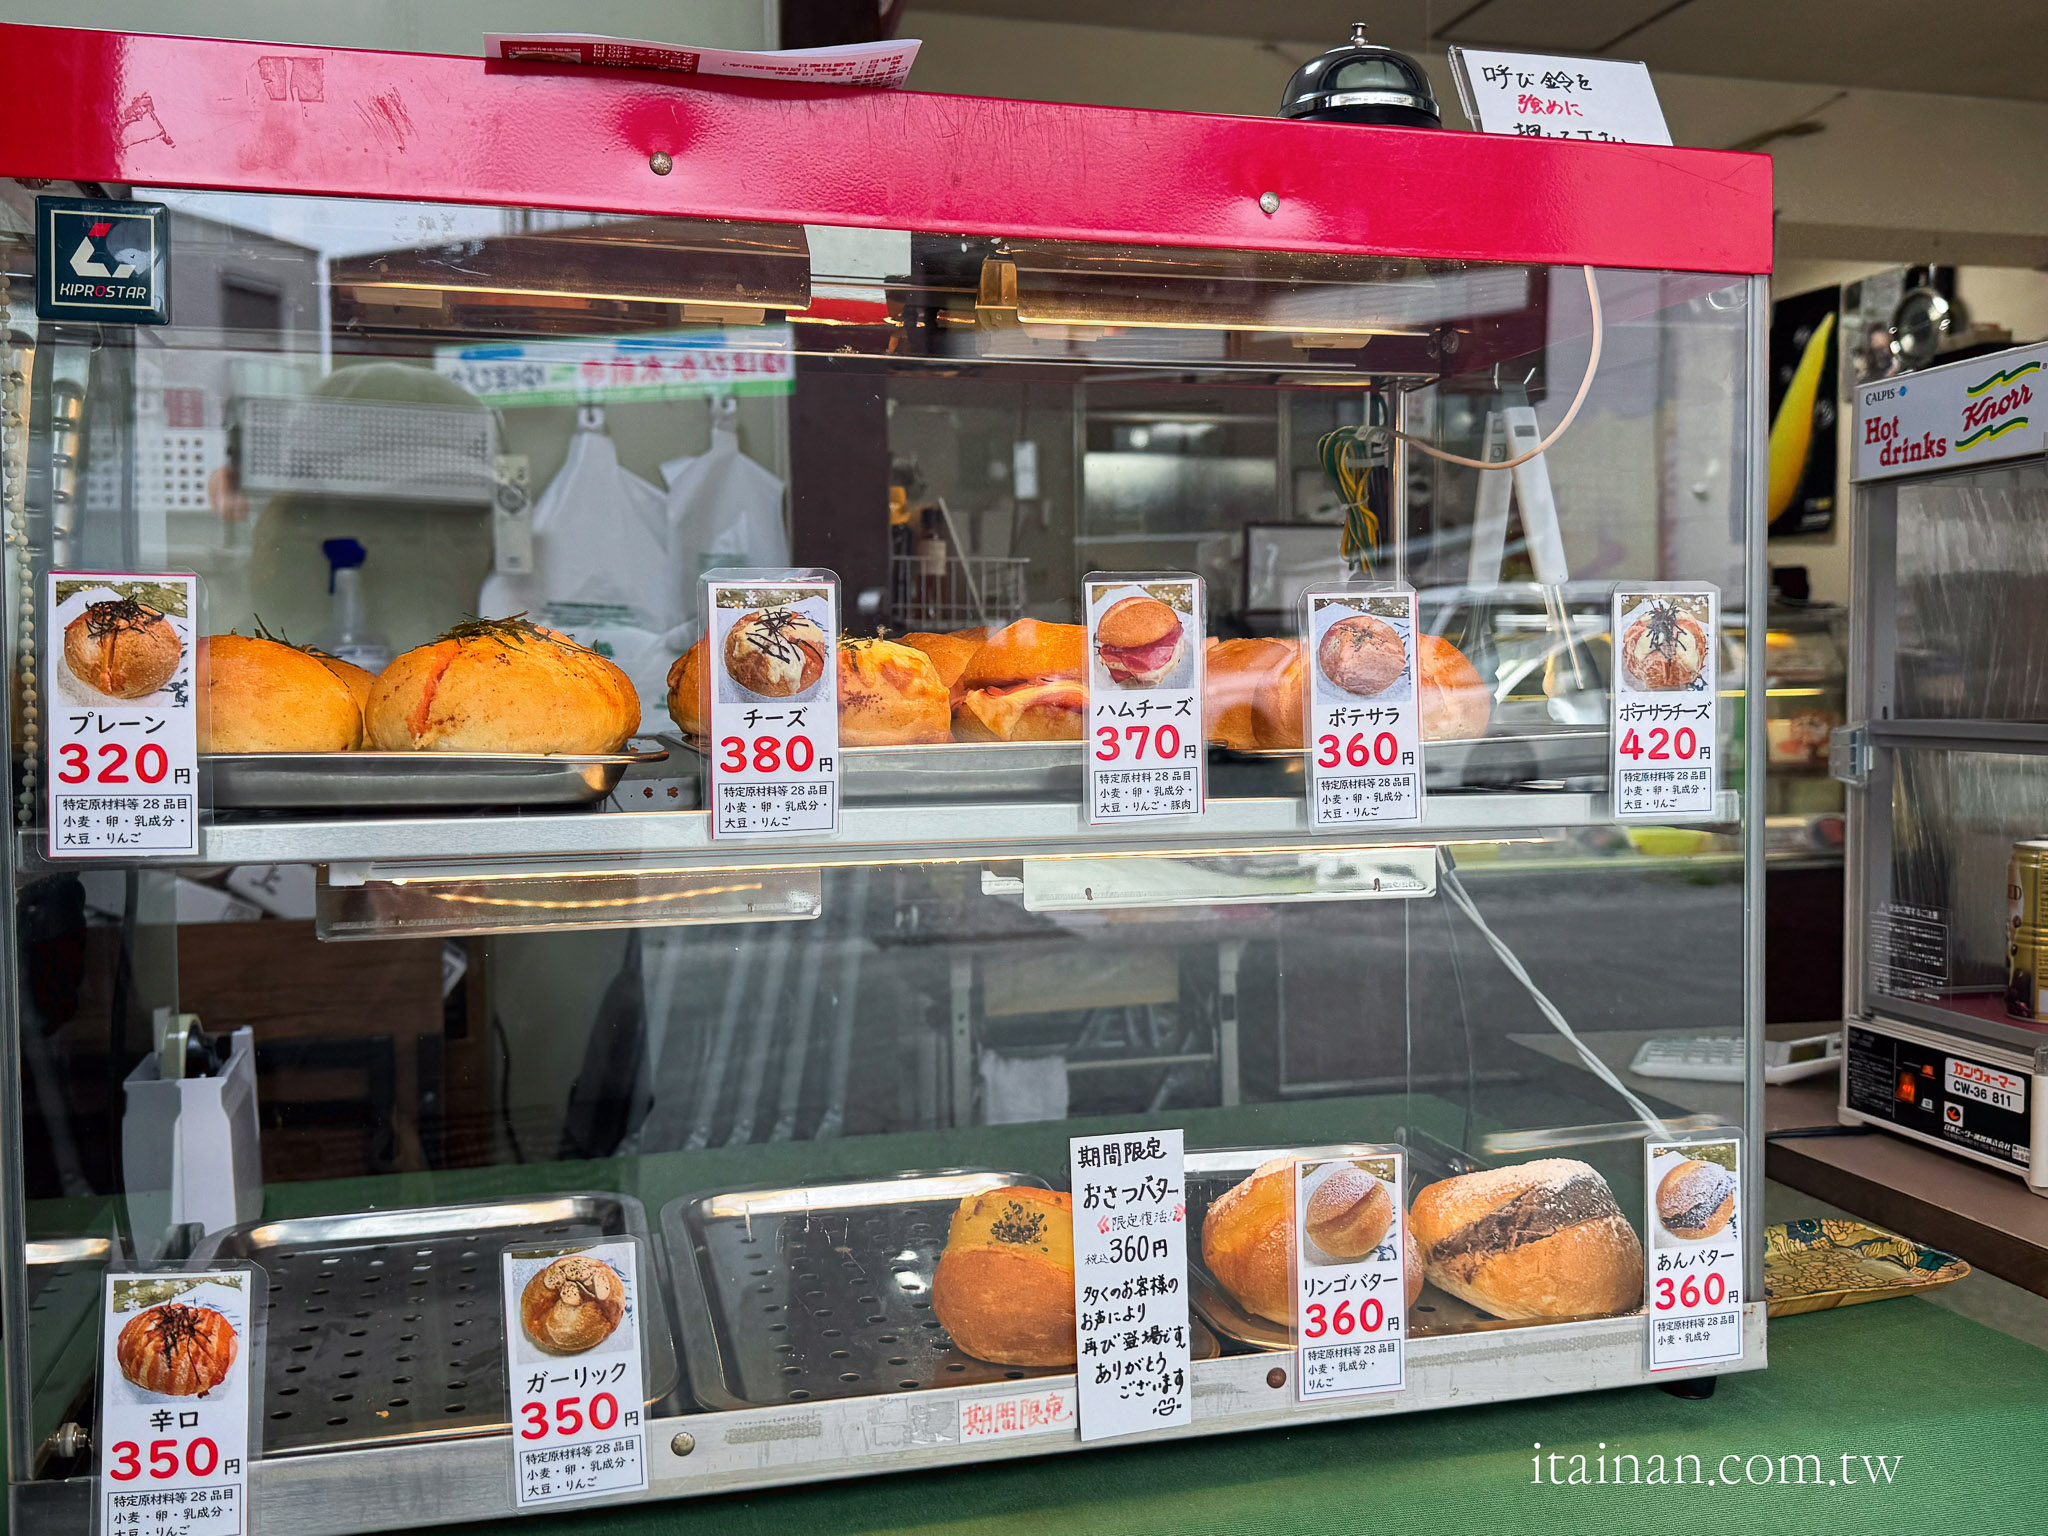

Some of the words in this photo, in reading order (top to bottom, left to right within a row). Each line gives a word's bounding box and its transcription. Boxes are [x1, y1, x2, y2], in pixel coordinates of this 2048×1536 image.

[1481, 65, 1593, 94] 呼び鈴を
[1517, 94, 1584, 117] 強めに
[59, 282, 147, 300] KIPROSTAR
[1865, 387, 1896, 406] CALPIS
[1961, 383, 2034, 433] Knorr
[1864, 415, 1900, 446] Hot
[1879, 430, 1948, 468] drinks
[742, 706, 808, 729] チーズ
[1096, 696, 1194, 719] ハムチーズ
[1328, 707, 1400, 728] ポテサラ
[1619, 701, 1713, 722] ポテサラチーズ
[69, 711, 166, 735] プレーン
[719, 734, 833, 774] 380円
[1095, 724, 1197, 762] 370円
[1317, 731, 1414, 769] 360円
[1619, 726, 1711, 761] 420円
[58, 743, 190, 785] 320円
[1322, 806, 1380, 819] 大豆・りんご
[1623, 798, 1678, 810] 大豆・りんご
[724, 816, 791, 829] 大豆・りんご
[63, 832, 142, 845] 大豆・りんご
[1952, 1061, 2017, 1089] カンウォーマー
[1952, 1080, 1988, 1101] CW-36
[1991, 1093, 2012, 1108] 811
[1077, 1136, 1168, 1169] 期間限定
[1083, 1175, 1179, 1210] おさつバター
[1656, 1249, 1735, 1272] あんバター
[1082, 1273, 1179, 1306] 多くのお客様の
[1304, 1273, 1398, 1298] リンゴバター
[1655, 1272, 1739, 1311] 360円
[1080, 1302, 1146, 1331] お声により
[1304, 1297, 1400, 1339] 360円
[526, 1362, 627, 1394] ガーリック
[1095, 1351, 1167, 1384] ありがとう
[1119, 1367, 1184, 1400] ございます
[1308, 1377, 1335, 1390] りんご
[149, 1408, 199, 1433] 辛口
[520, 1391, 639, 1441] 350円
[962, 1392, 1074, 1436] 期間限定
[109, 1436, 241, 1482] 350円
[527, 1475, 598, 1497] 大豆・りんご
